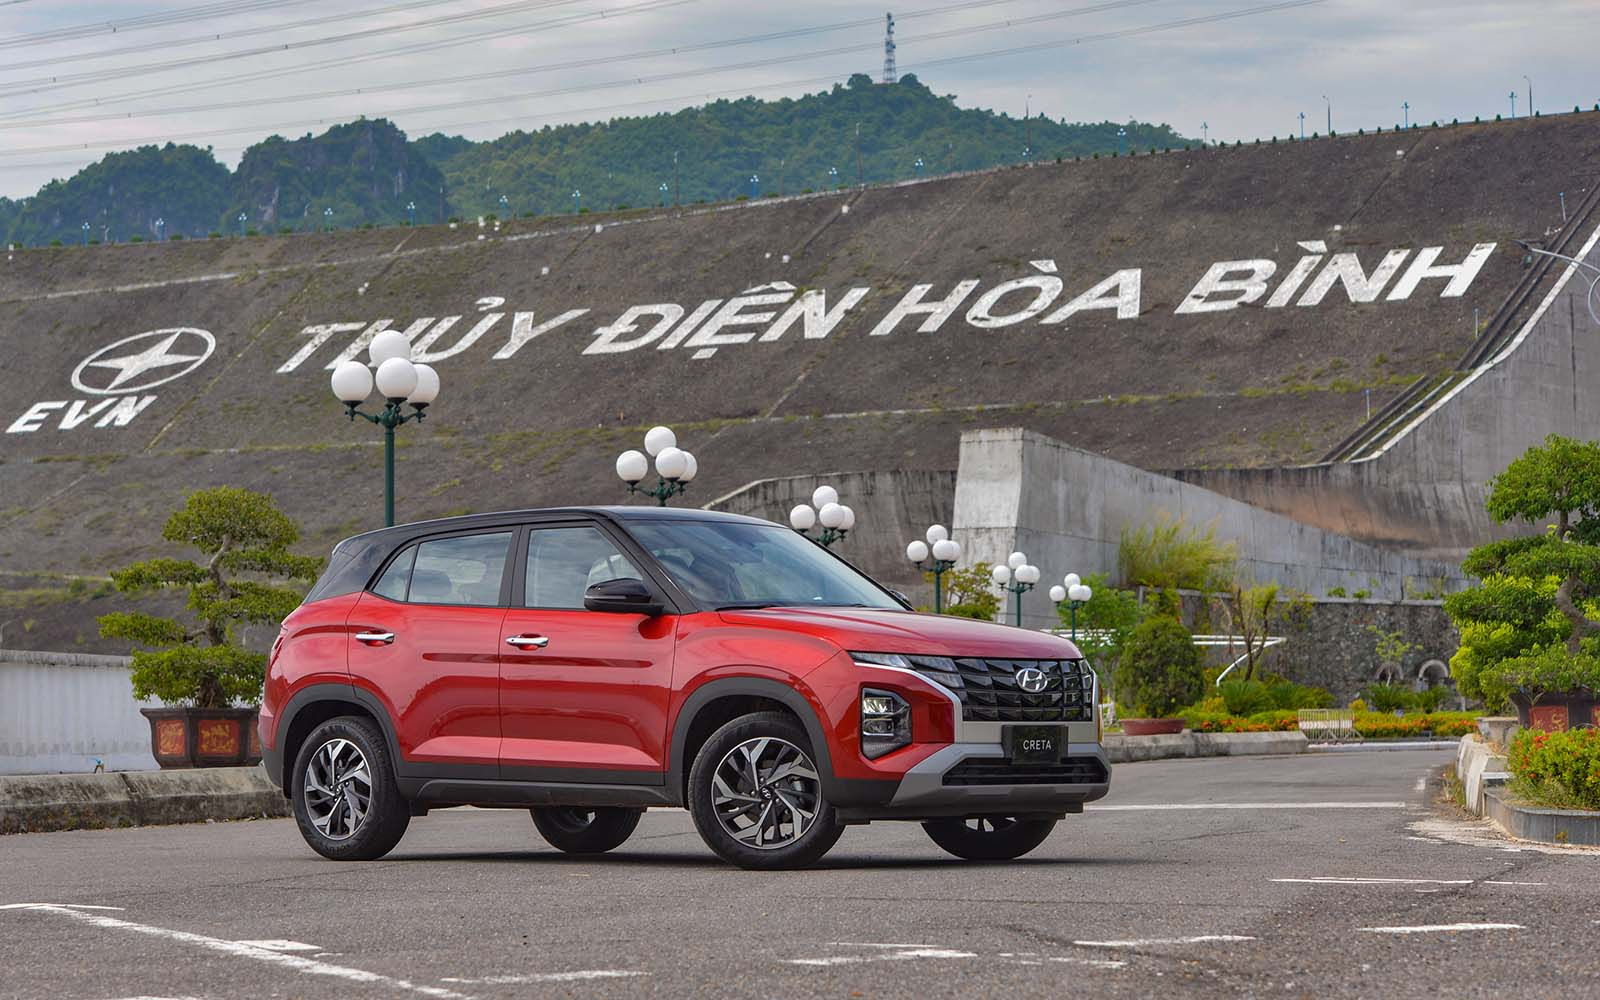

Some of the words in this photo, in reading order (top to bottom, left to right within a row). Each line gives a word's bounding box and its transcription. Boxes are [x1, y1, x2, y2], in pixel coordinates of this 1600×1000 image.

[582, 281, 870, 360] ĐIỆN
[869, 260, 1142, 336] HÒA
[1174, 240, 1497, 314] BÌNH
[5, 395, 158, 434] EVN
[1022, 739, 1052, 751] CRETA
